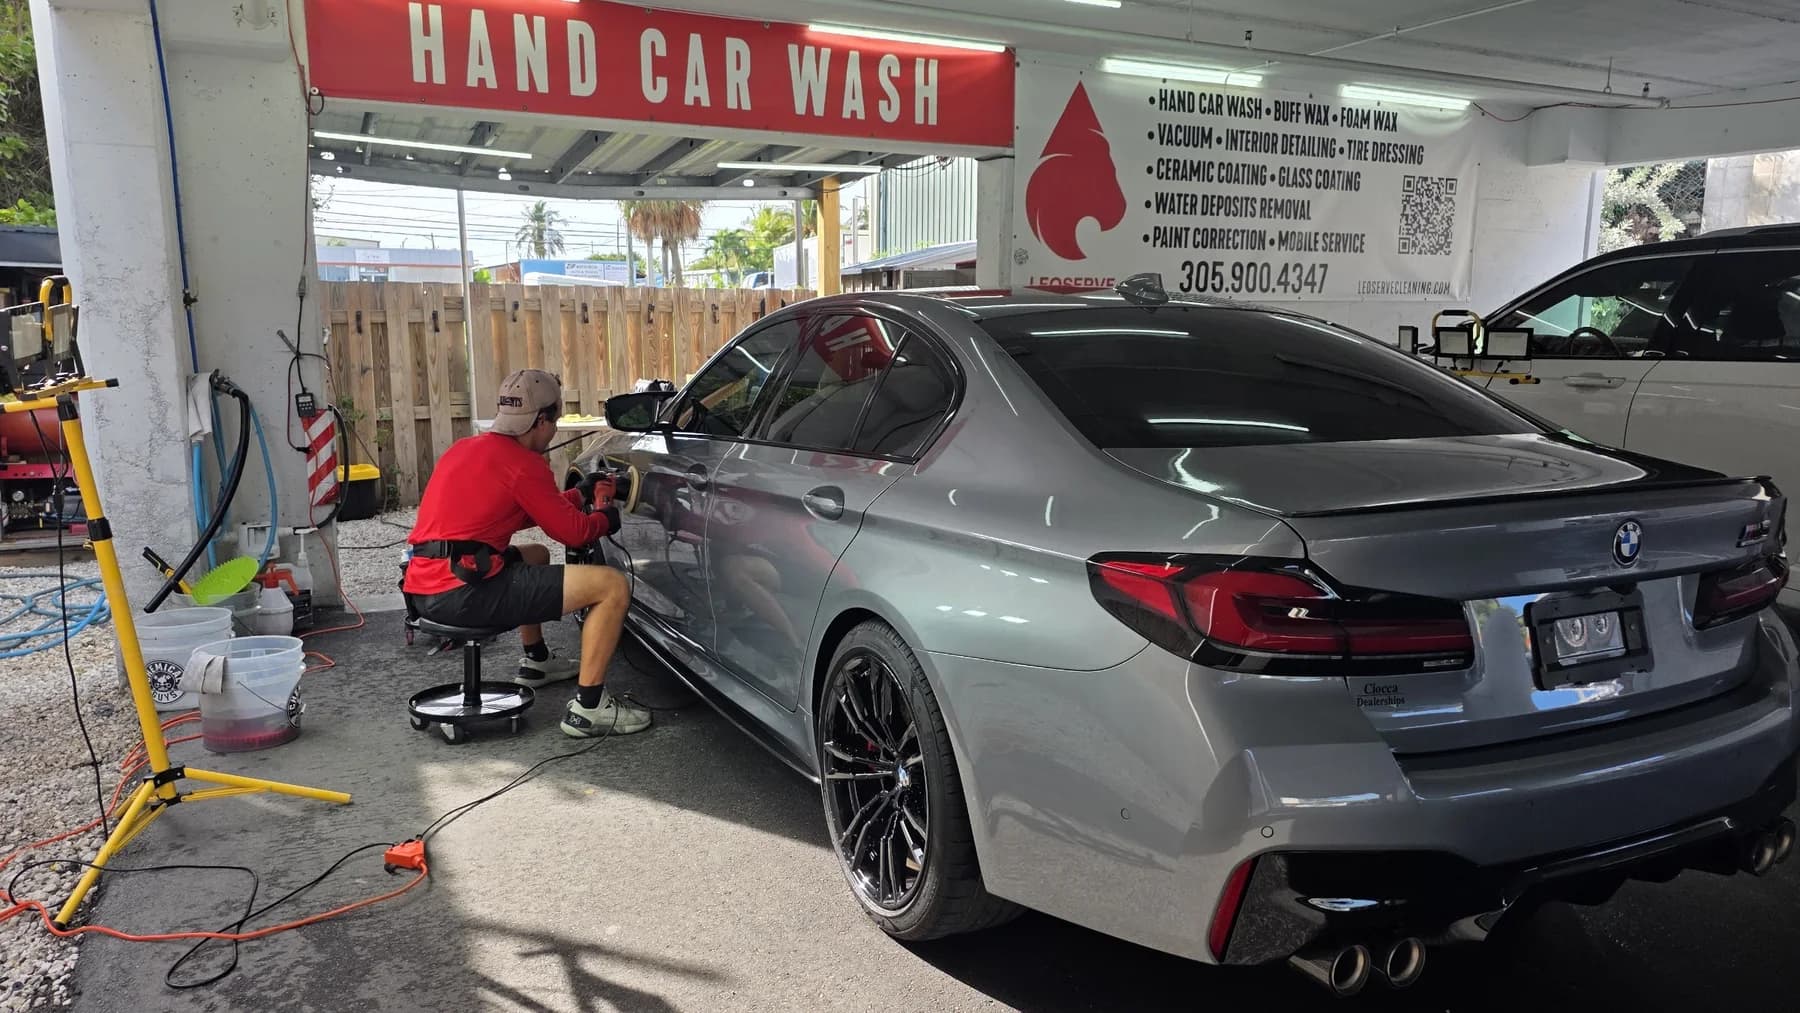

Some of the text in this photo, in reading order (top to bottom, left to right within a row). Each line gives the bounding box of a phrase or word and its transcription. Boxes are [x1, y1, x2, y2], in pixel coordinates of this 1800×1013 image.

[409, 2, 938, 125] HAND CAR WASH
[1159, 89, 1397, 132] HAND CAR WASH BUFF WAX FOAM WAX
[1158, 124, 1424, 165] VACUUM INTERIOR DETAILING TIRE DRESSING
[1157, 158, 1360, 191] CERAMIC COATING GLASS COATING
[1155, 192, 1310, 220] WATER DEPOSITS REMOVAL
[1153, 226, 1365, 253] PAINT CORRECTION MOBILE SERVICE
[1179, 261, 1329, 294] 305.900.4347
[1357, 280, 1451, 296] LEOSERVECLEANING.COM
[1357, 695, 1406, 707] Dealerships
[1363, 682, 1399, 695] Ciocca
